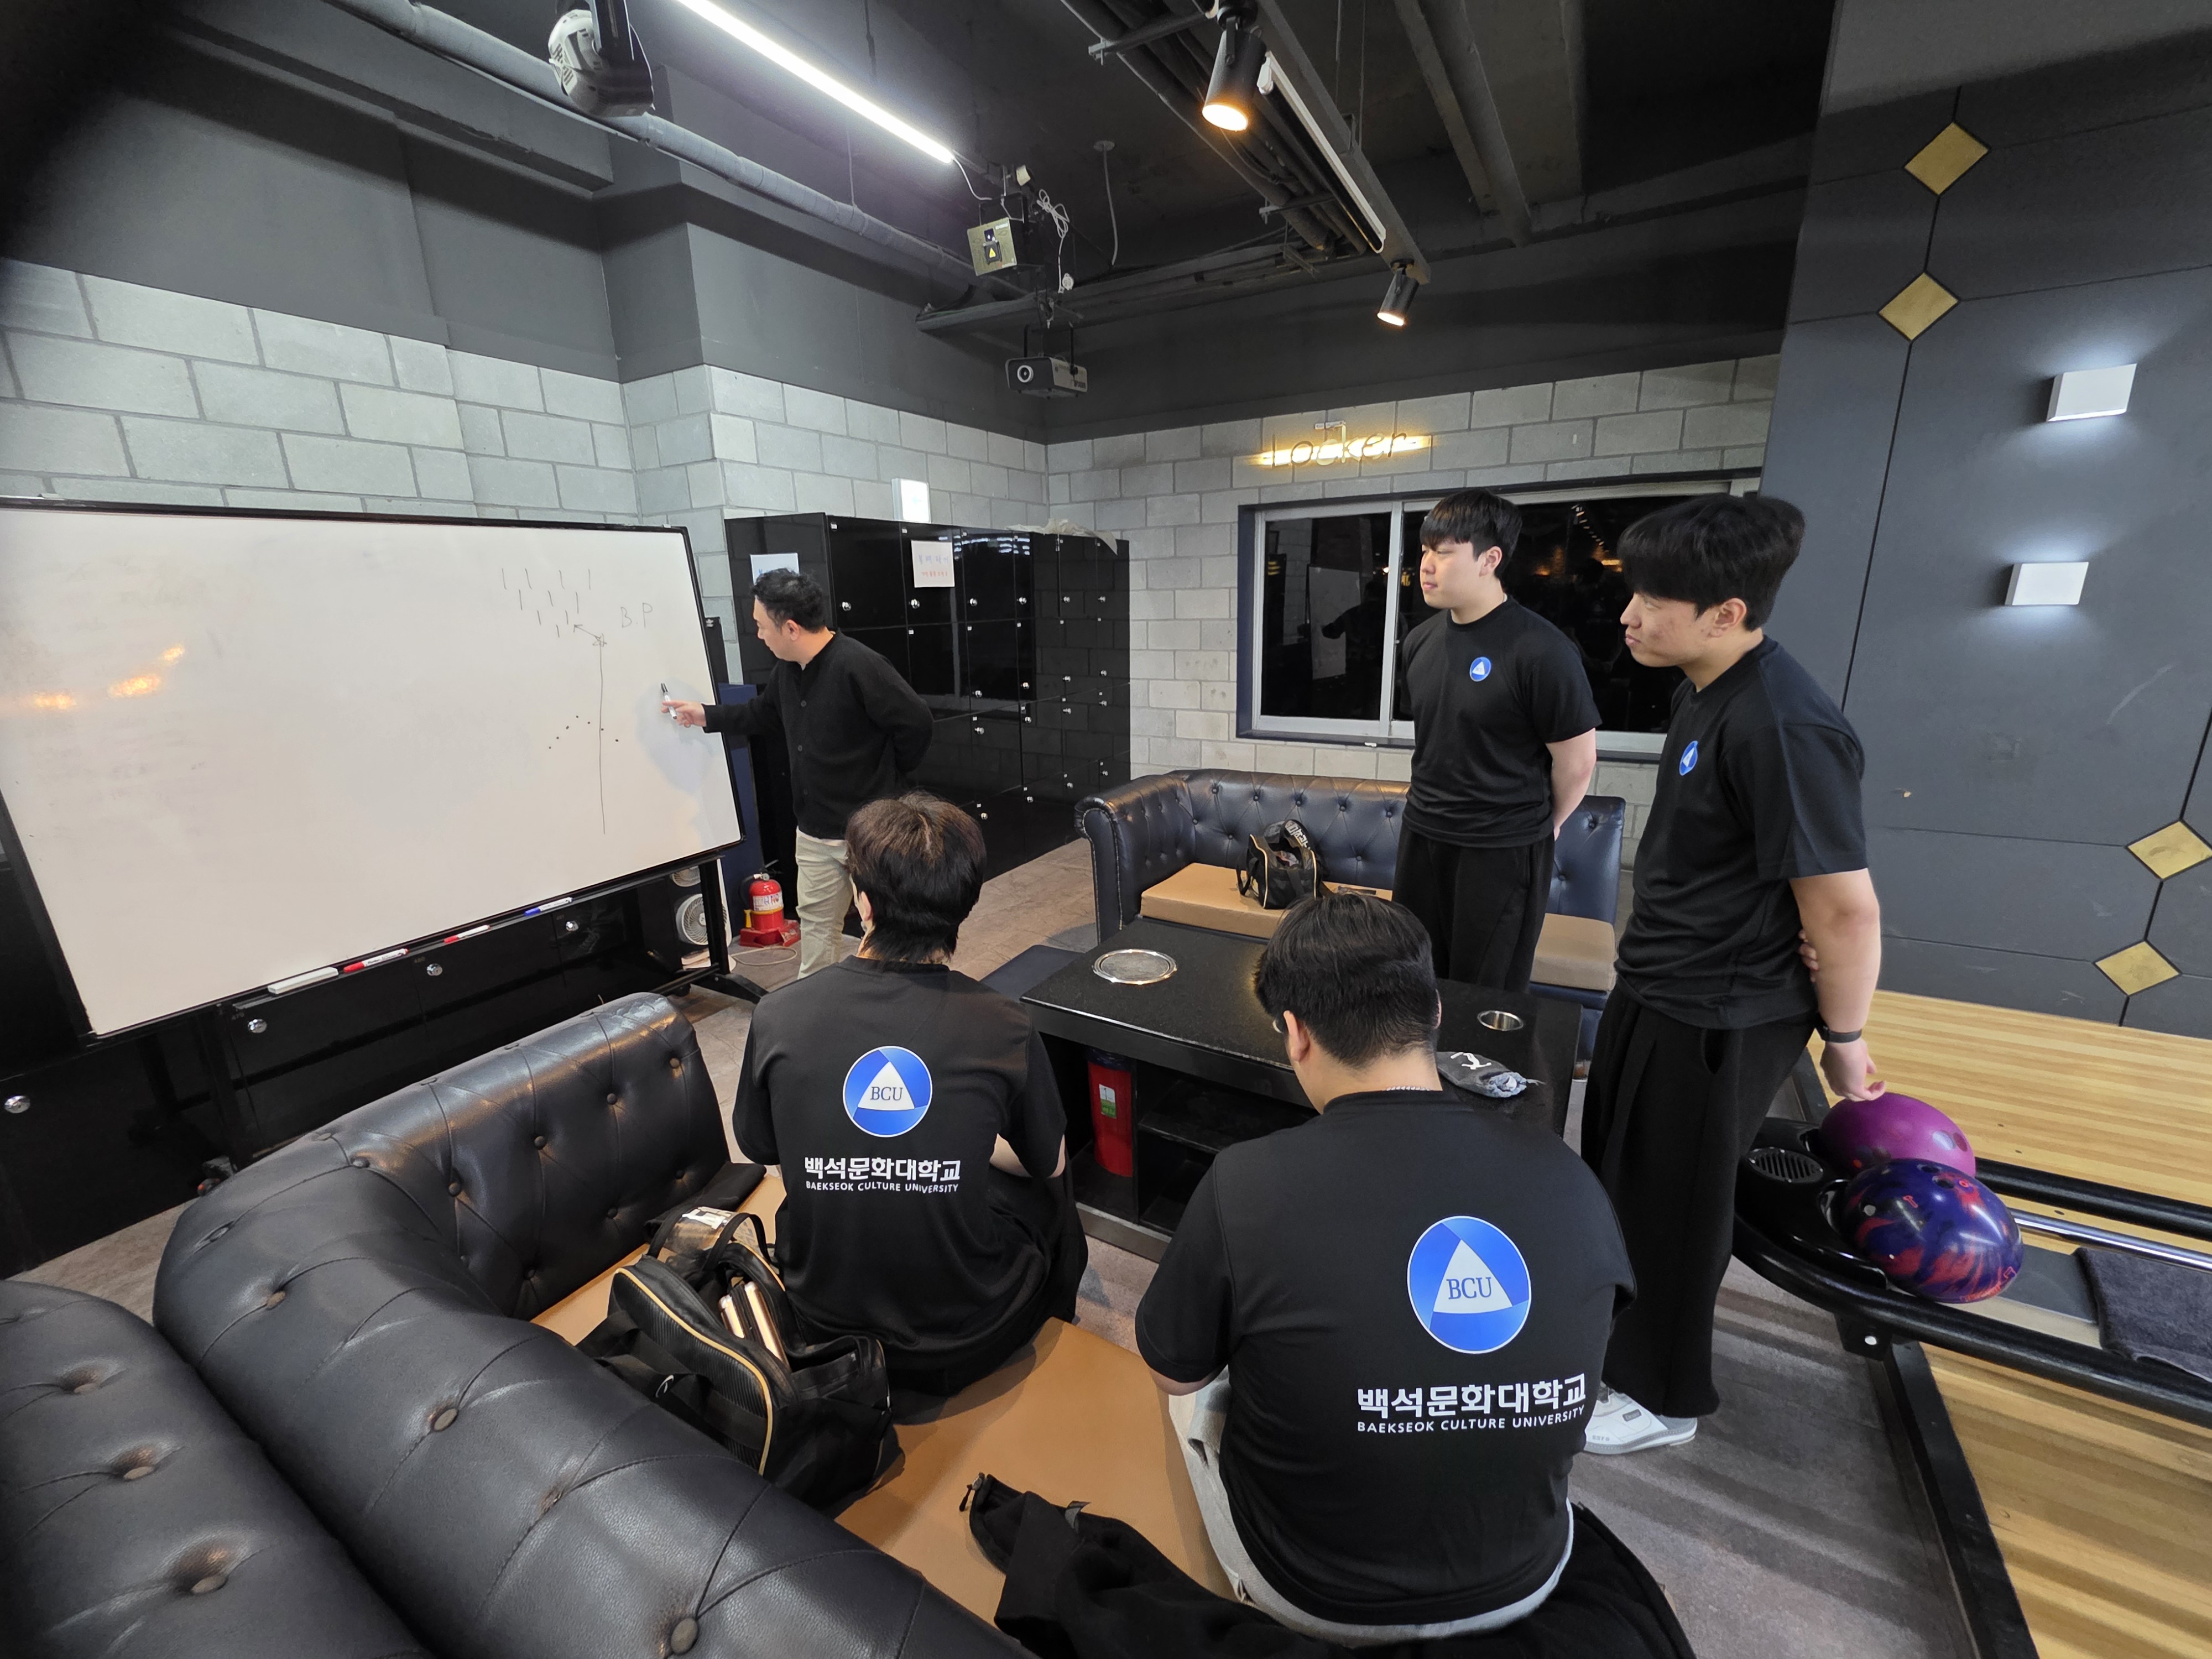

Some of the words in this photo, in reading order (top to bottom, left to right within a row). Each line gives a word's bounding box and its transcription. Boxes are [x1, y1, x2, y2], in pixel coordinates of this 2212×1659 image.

[870, 1086, 904, 1101] BCU
[804, 1156, 961, 1182] 백석문화대학교
[806, 1181, 854, 1191] BAEKSEOK
[858, 1181, 900, 1191] CULTURE
[905, 1183, 958, 1193] UNIVERSITY
[1446, 1277, 1493, 1300] BCU
[1357, 1373, 1586, 1418] 백석문화대학교
[1358, 1421, 1434, 1434] BAEKSEOK
[1441, 1418, 1505, 1431] CULTURE
[1512, 1405, 1585, 1428] UNIVERSITY
